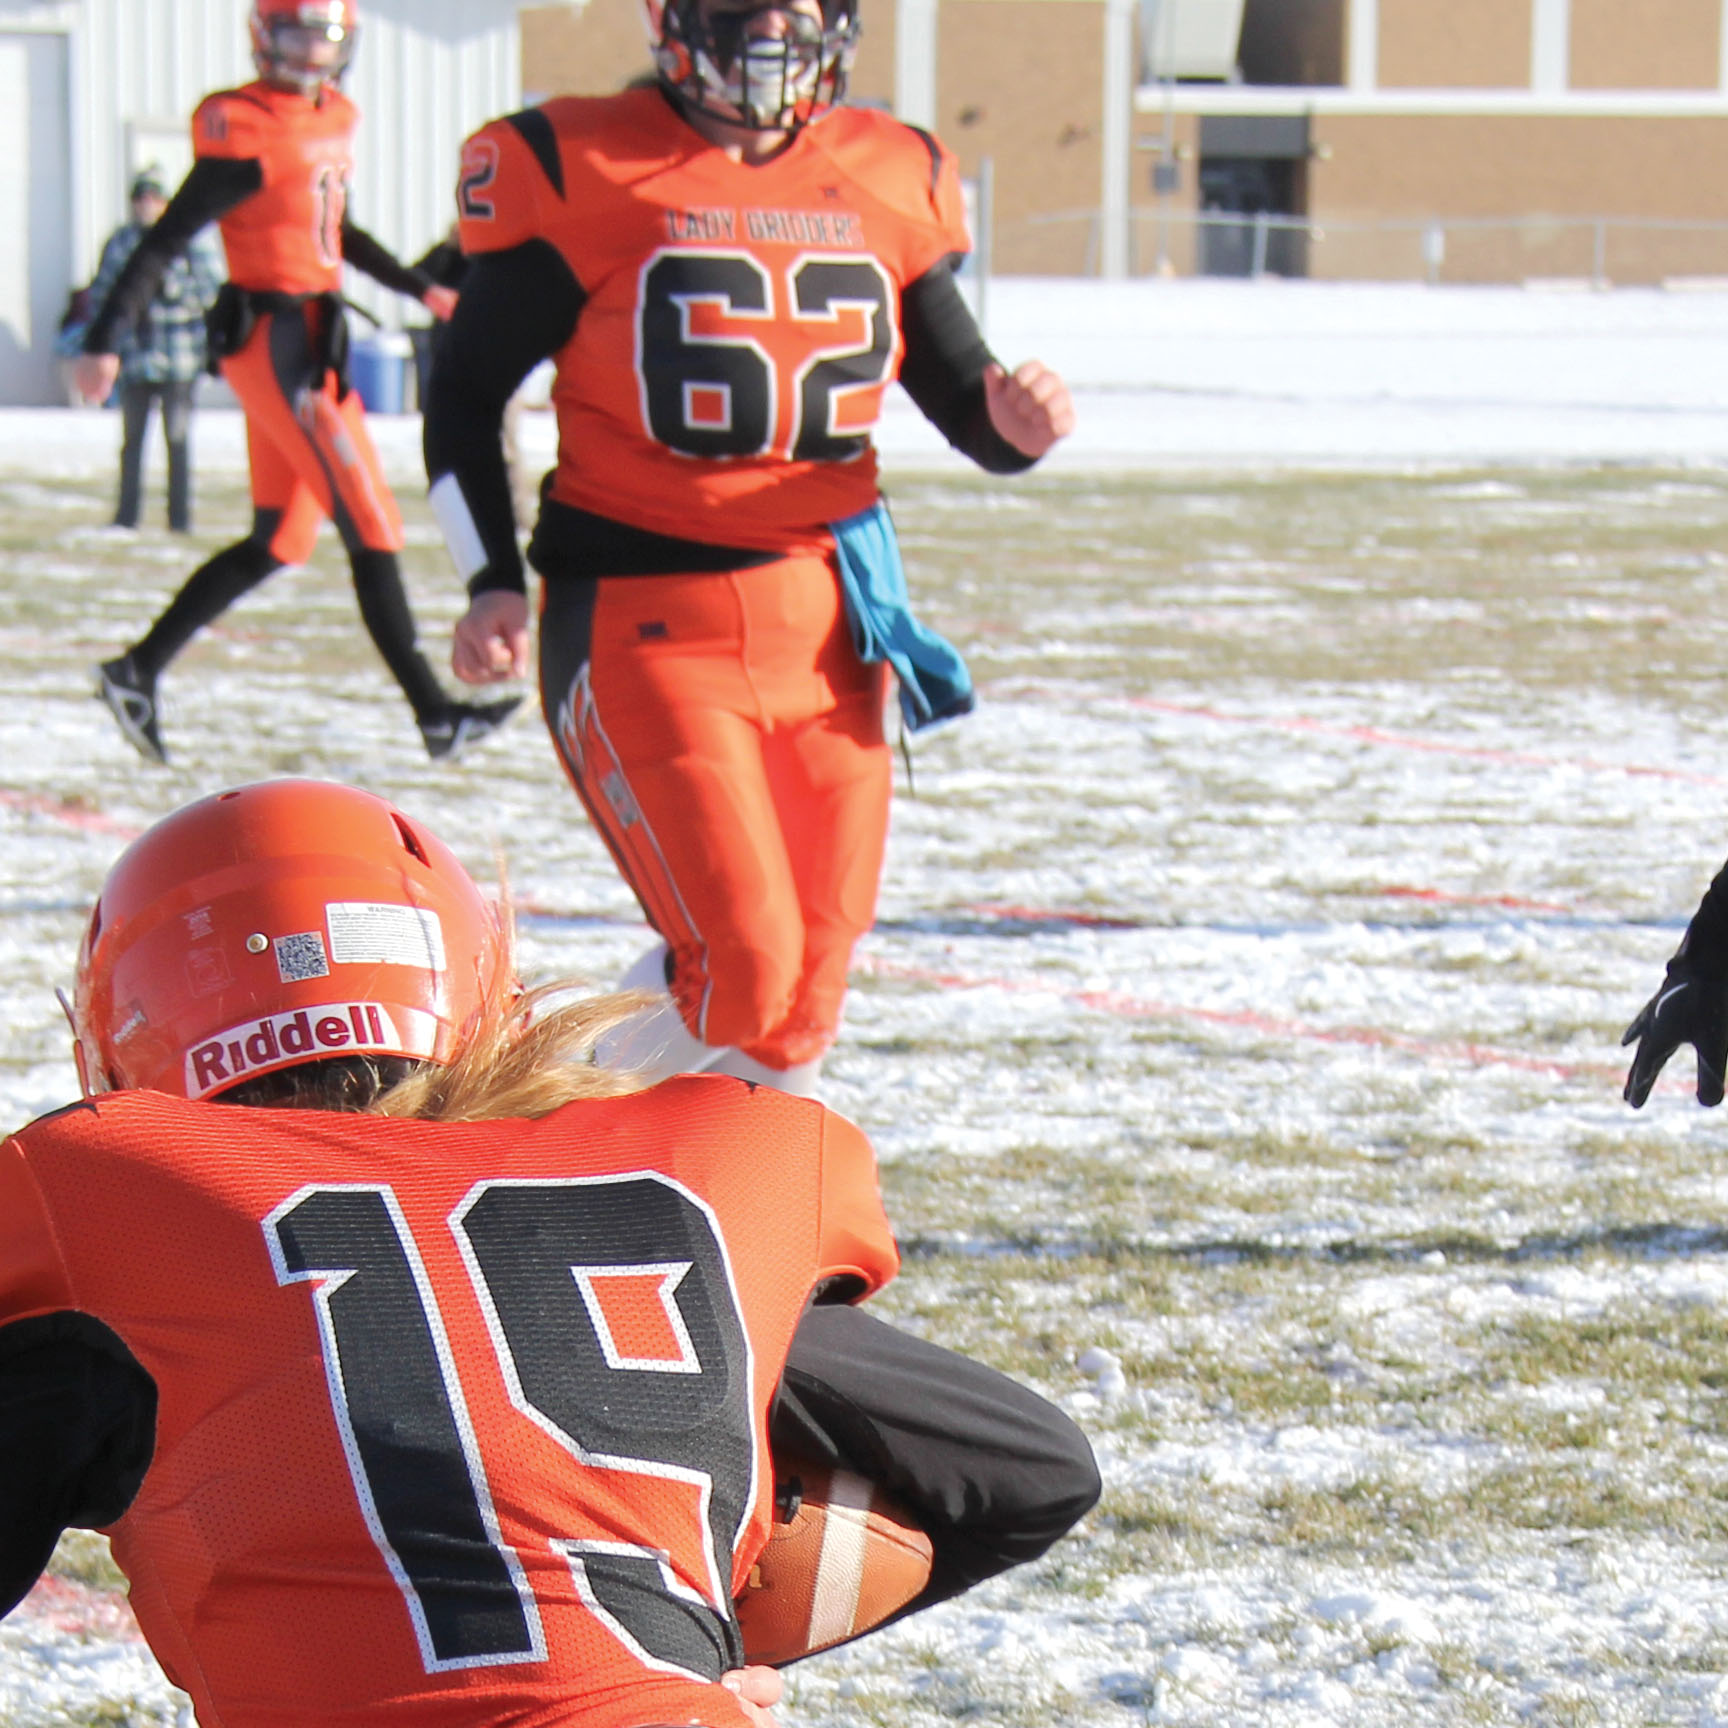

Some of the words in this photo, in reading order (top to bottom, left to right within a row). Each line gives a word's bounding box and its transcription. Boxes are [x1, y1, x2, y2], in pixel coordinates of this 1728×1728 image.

[666, 206, 736, 241] LADY
[634, 247, 897, 463] 62
[190, 1005, 386, 1091] Riddell
[260, 1168, 758, 1686] 19
